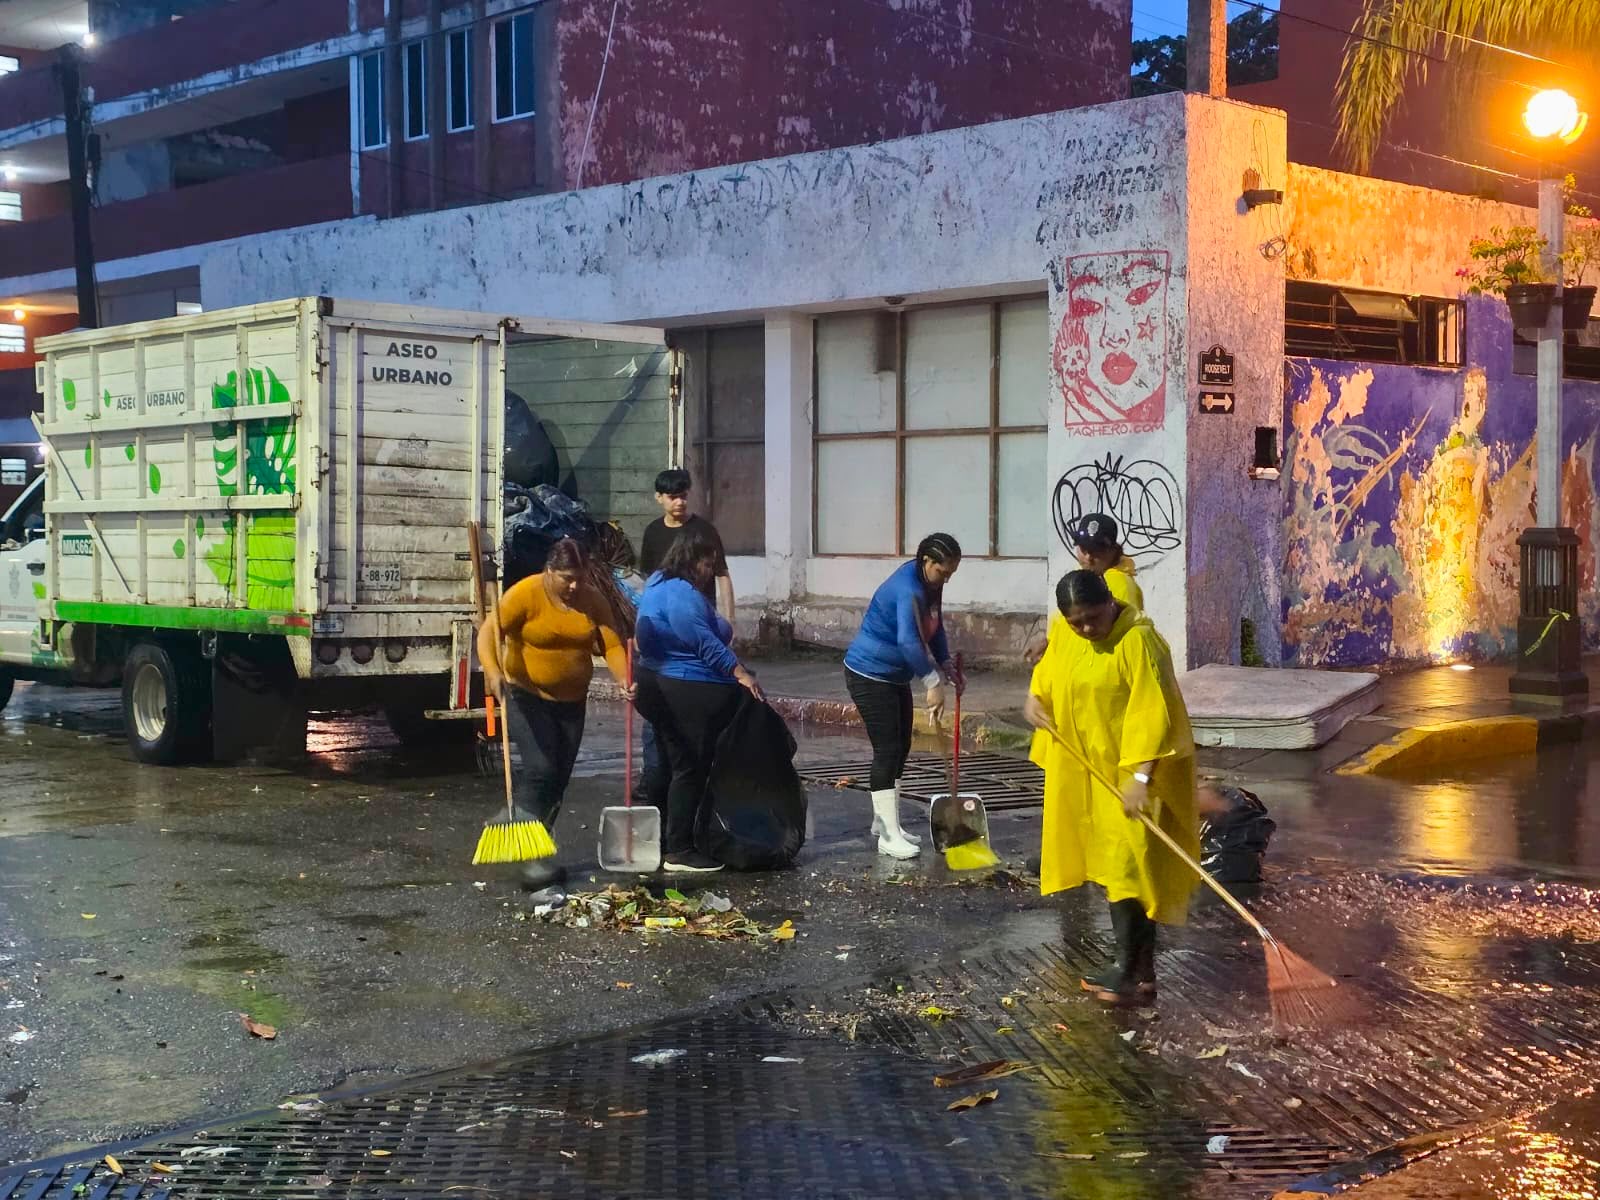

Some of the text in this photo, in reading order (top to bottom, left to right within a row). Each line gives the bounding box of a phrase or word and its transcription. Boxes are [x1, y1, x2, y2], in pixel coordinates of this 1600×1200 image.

[387, 342, 437, 359] ASEO
[372, 367, 452, 386] URBANO
[146, 391, 185, 407] URBANO
